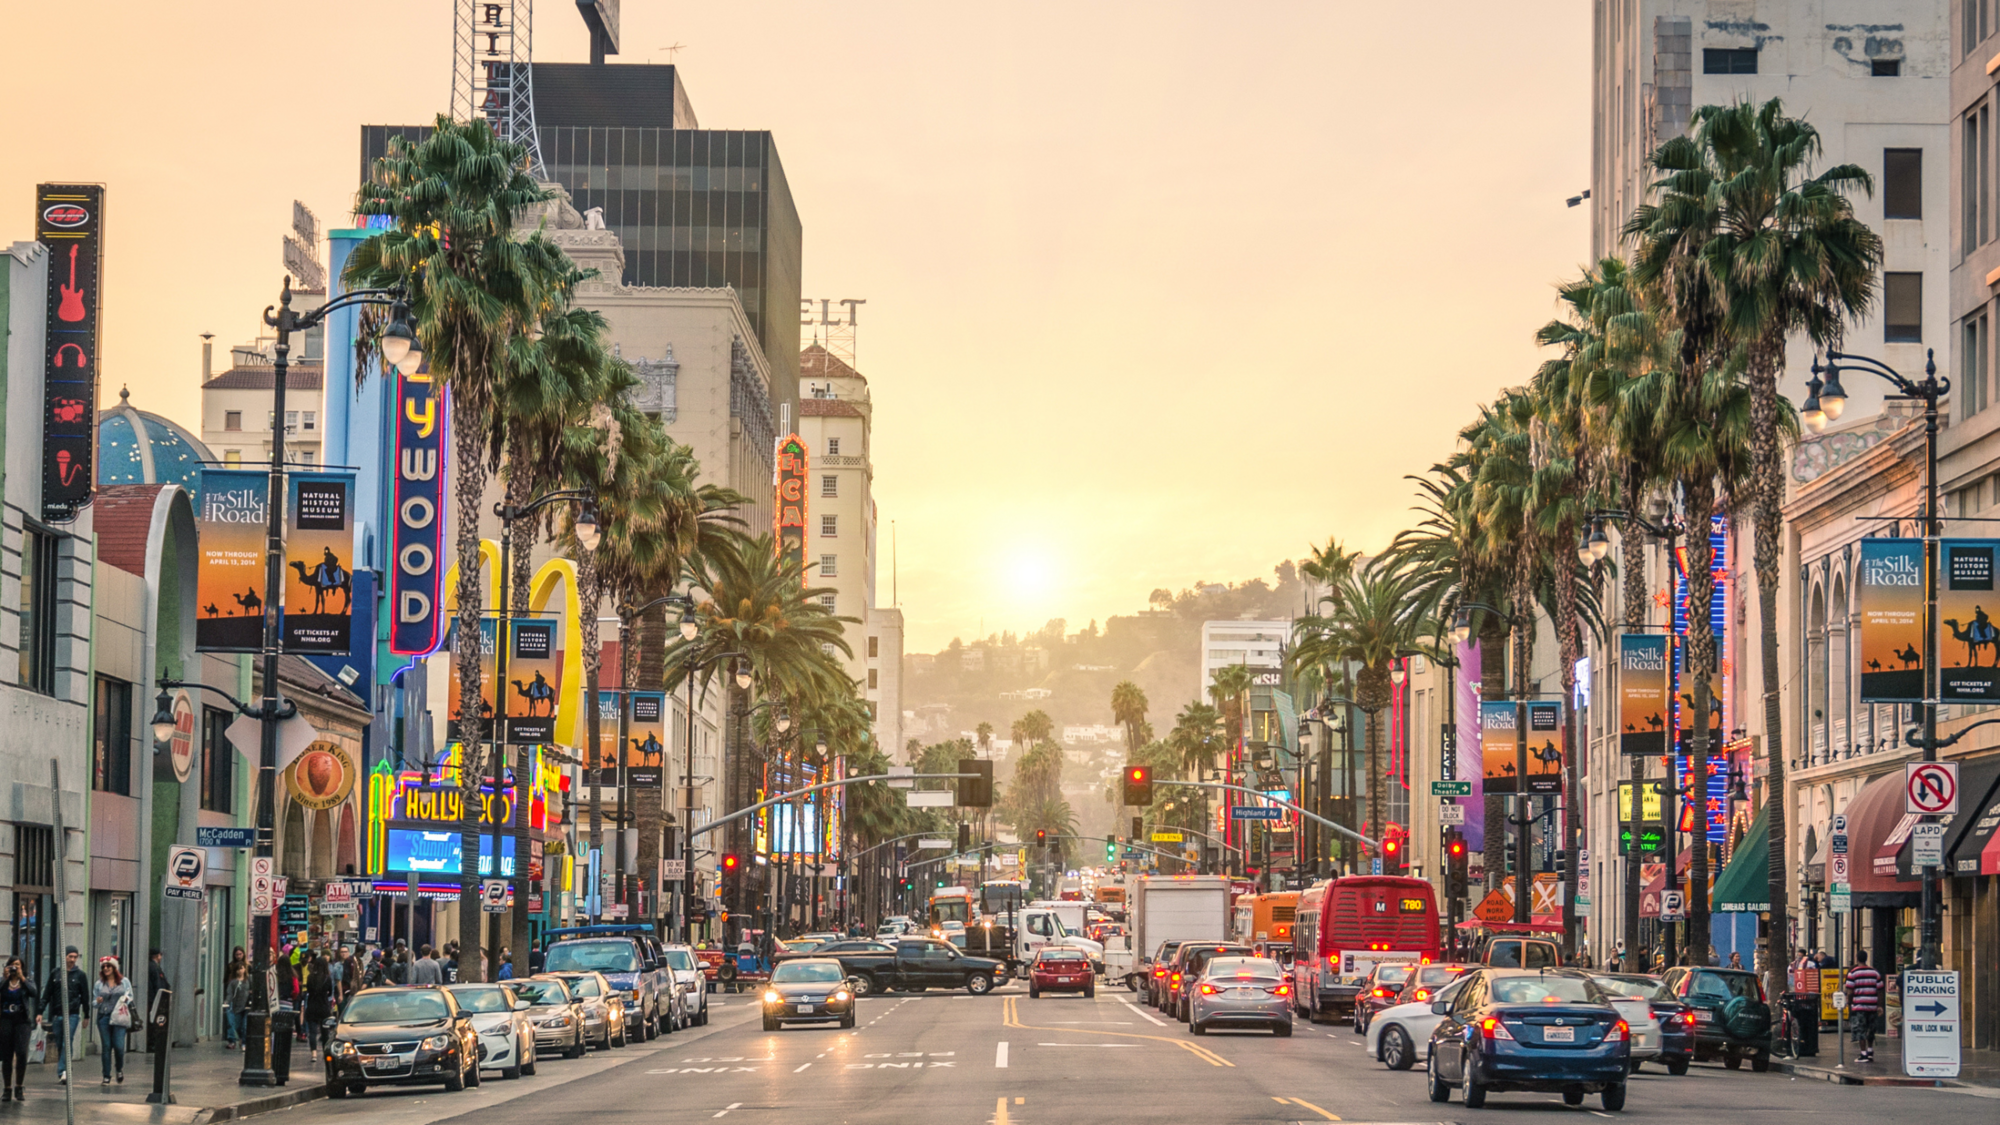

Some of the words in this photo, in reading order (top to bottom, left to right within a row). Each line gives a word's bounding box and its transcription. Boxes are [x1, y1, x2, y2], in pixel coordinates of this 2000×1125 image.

[782, 453, 803, 475] EL
[212, 492, 226, 502] The
[226, 490, 259, 508] Silk
[212, 503, 264, 524] Road
[1872, 559, 1884, 567] The
[1884, 556, 1914, 572] Silk
[1871, 567, 1920, 586] Road
[1638, 648, 1659, 660] Silk
[1628, 656, 1664, 670] Road
[1495, 711, 1512, 721] Silk
[1487, 718, 1515, 729] Road
[296, 792, 318, 808] Since
[322, 794, 341, 808] 1989
[1236, 809, 1266, 817] Highland
[200, 828, 244, 839] McCadden
[328, 885, 348, 895] ATM
[1376, 902, 1385, 911] M
[1404, 900, 1422, 910] 780
[450, 972, 456, 982] 5
[1907, 976, 1954, 984] PUBLIC
[1907, 986, 1955, 994] PARKING
